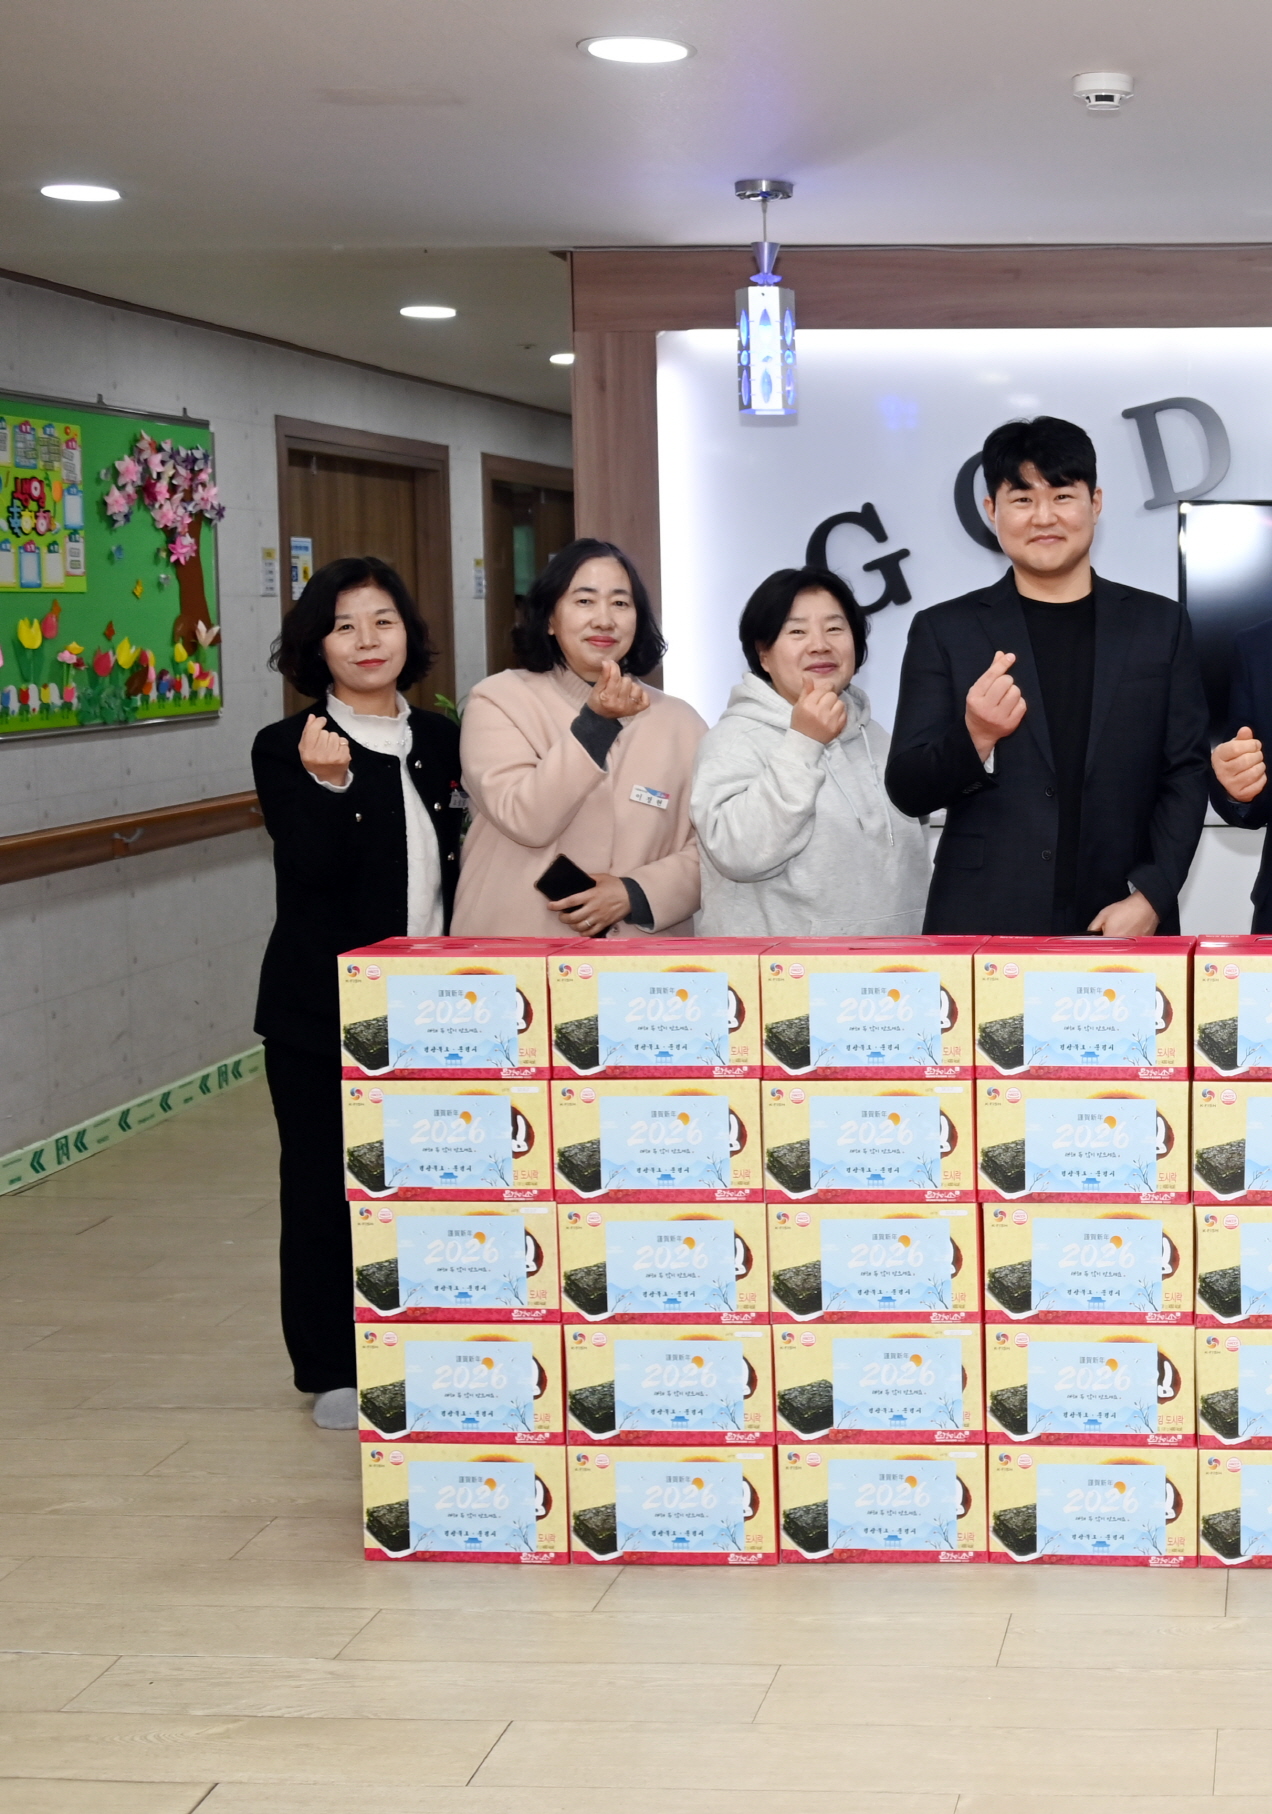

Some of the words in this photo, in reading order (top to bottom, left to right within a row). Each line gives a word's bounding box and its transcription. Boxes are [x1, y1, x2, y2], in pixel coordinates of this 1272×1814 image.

[438, 990, 465, 998] 謹賀新年
[650, 987, 676, 995] 謹賀新年
[861, 987, 888, 995] 謹賀新年
[1077, 987, 1103, 995] 謹賀新年
[414, 997, 491, 1027] 2026
[625, 994, 702, 1024] 2026
[836, 995, 914, 1024] 2026
[1051, 993, 1129, 1025] 2026
[434, 1109, 460, 1117] 謹賀新年
[651, 1111, 677, 1119] 謹賀新年
[862, 1110, 888, 1119] 謹賀新年
[1078, 1114, 1104, 1122] 謹賀新年
[409, 1116, 486, 1146] 2026
[626, 1117, 704, 1147] 2026
[837, 1117, 914, 1148] 2026
[1052, 1120, 1130, 1151] 2026
[448, 1230, 474, 1238] 謹賀新年
[657, 1235, 683, 1243] 謹賀新年
[872, 1233, 898, 1241] 謹賀新年
[1084, 1233, 1110, 1242] 謹賀新年
[423, 1236, 500, 1266] 2026
[632, 1242, 710, 1271] 2026
[847, 1240, 925, 1269] 2026
[1059, 1239, 1136, 1271] 2026
[456, 1355, 482, 1363] 謹賀新年
[666, 1354, 692, 1362] 謹賀新年
[884, 1352, 910, 1360] 謹賀新年
[1080, 1356, 1106, 1365] 謹賀新年
[431, 1362, 508, 1392] 2026
[641, 1360, 718, 1390] 2026
[859, 1359, 936, 1388] 2026
[1055, 1363, 1131, 1393] 2026
[459, 1476, 484, 1484] 謹賀新年
[666, 1476, 692, 1484] 謹賀新年
[879, 1473, 905, 1482] 謹賀新年
[1088, 1479, 1114, 1487] 謹賀新年
[434, 1482, 510, 1512] 2026
[642, 1482, 718, 1512] 2026
[854, 1480, 931, 1510] 2026
[1063, 1485, 1139, 1516] 2026
